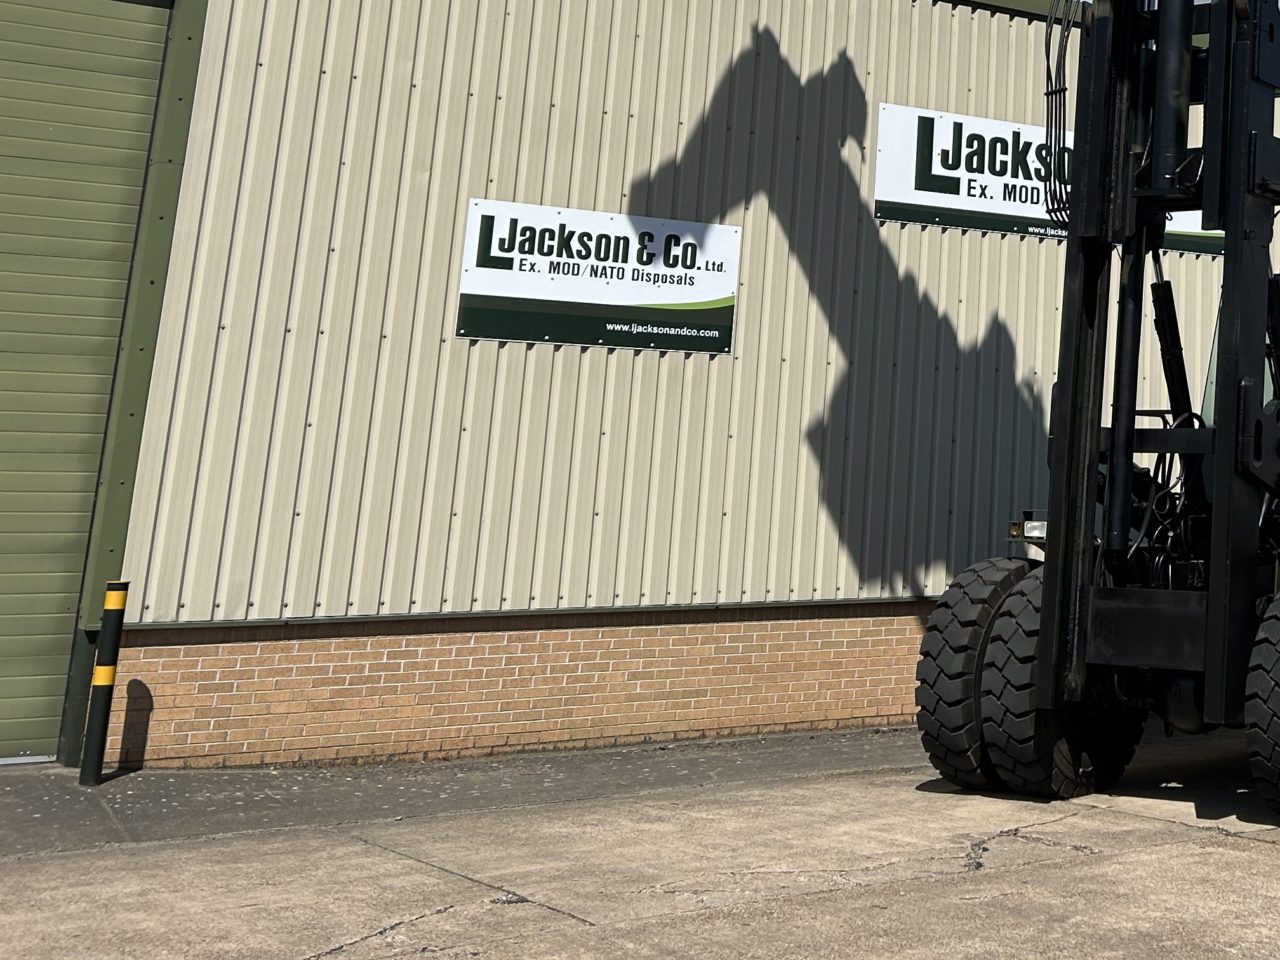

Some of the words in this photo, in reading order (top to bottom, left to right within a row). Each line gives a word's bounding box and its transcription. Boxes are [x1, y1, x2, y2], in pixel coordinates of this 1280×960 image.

[967, 178, 994, 200] Ex.
[636, 231, 656, 265] &
[662, 234, 702, 270] Co.
[705, 260, 727, 273] Ltd.
[518, 259, 541, 274] Ex.
[548, 262, 625, 280] MOD/NATO
[631, 269, 695, 286] Disposals
[606, 322, 719, 338] www.ljacksonandco.com
